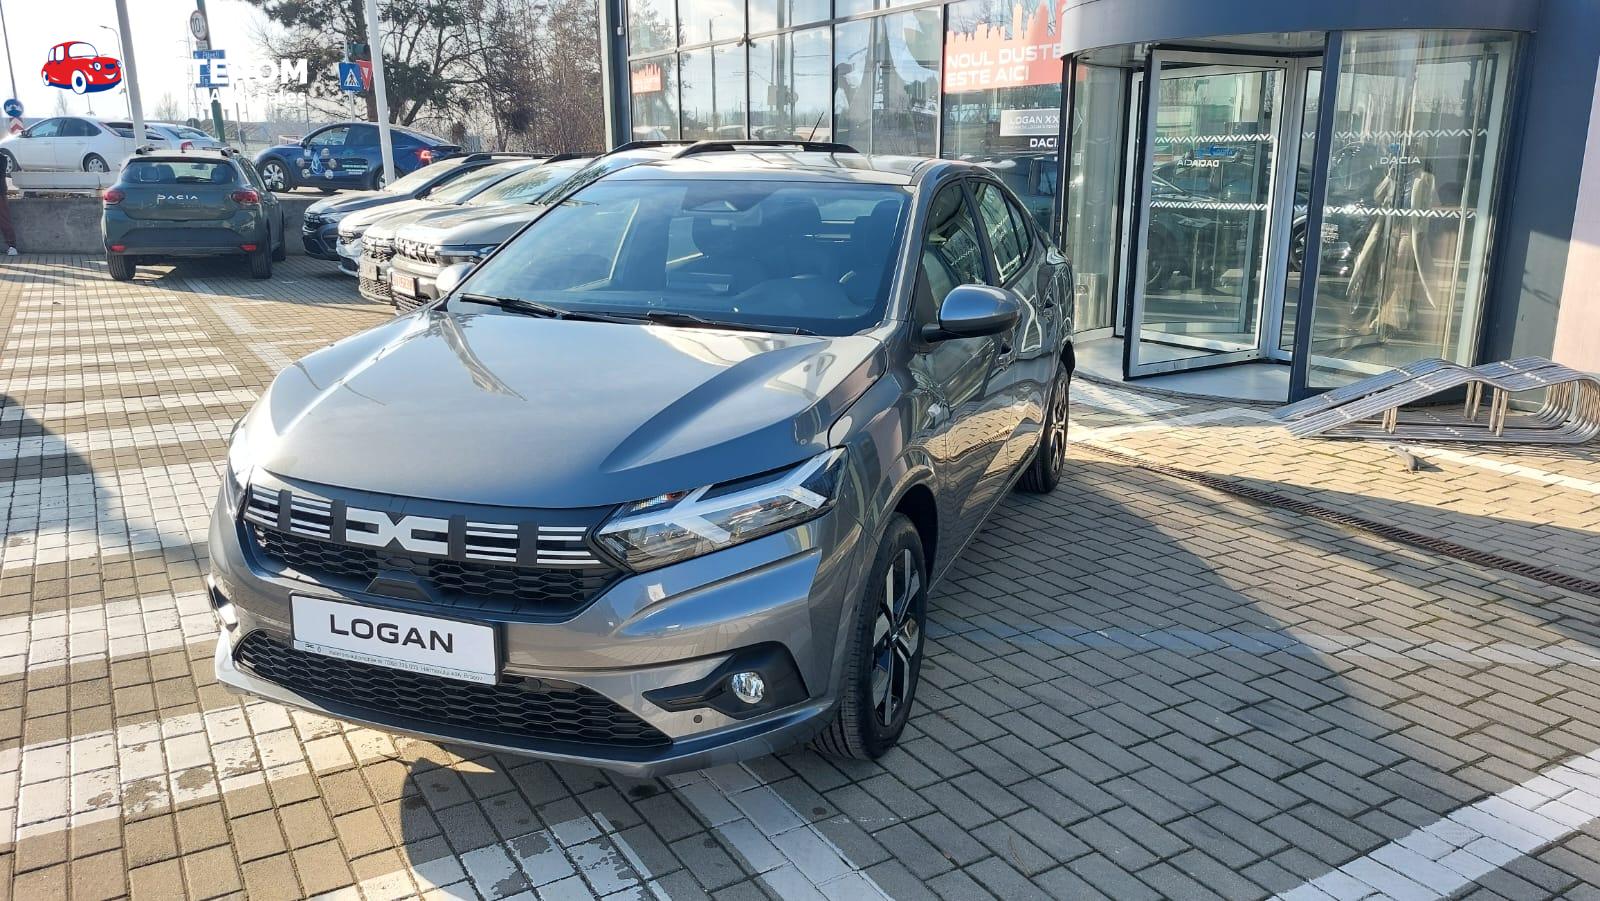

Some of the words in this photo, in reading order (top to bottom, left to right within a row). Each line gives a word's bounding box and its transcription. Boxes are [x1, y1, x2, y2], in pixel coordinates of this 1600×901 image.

[947, 51, 994, 68] NOUL
[947, 68, 990, 86] ESTE
[995, 65, 1029, 81] AICI
[1029, 137, 1059, 148] DACI
[1380, 156, 1421, 165] DACIA
[329, 613, 454, 654] LOGAN
